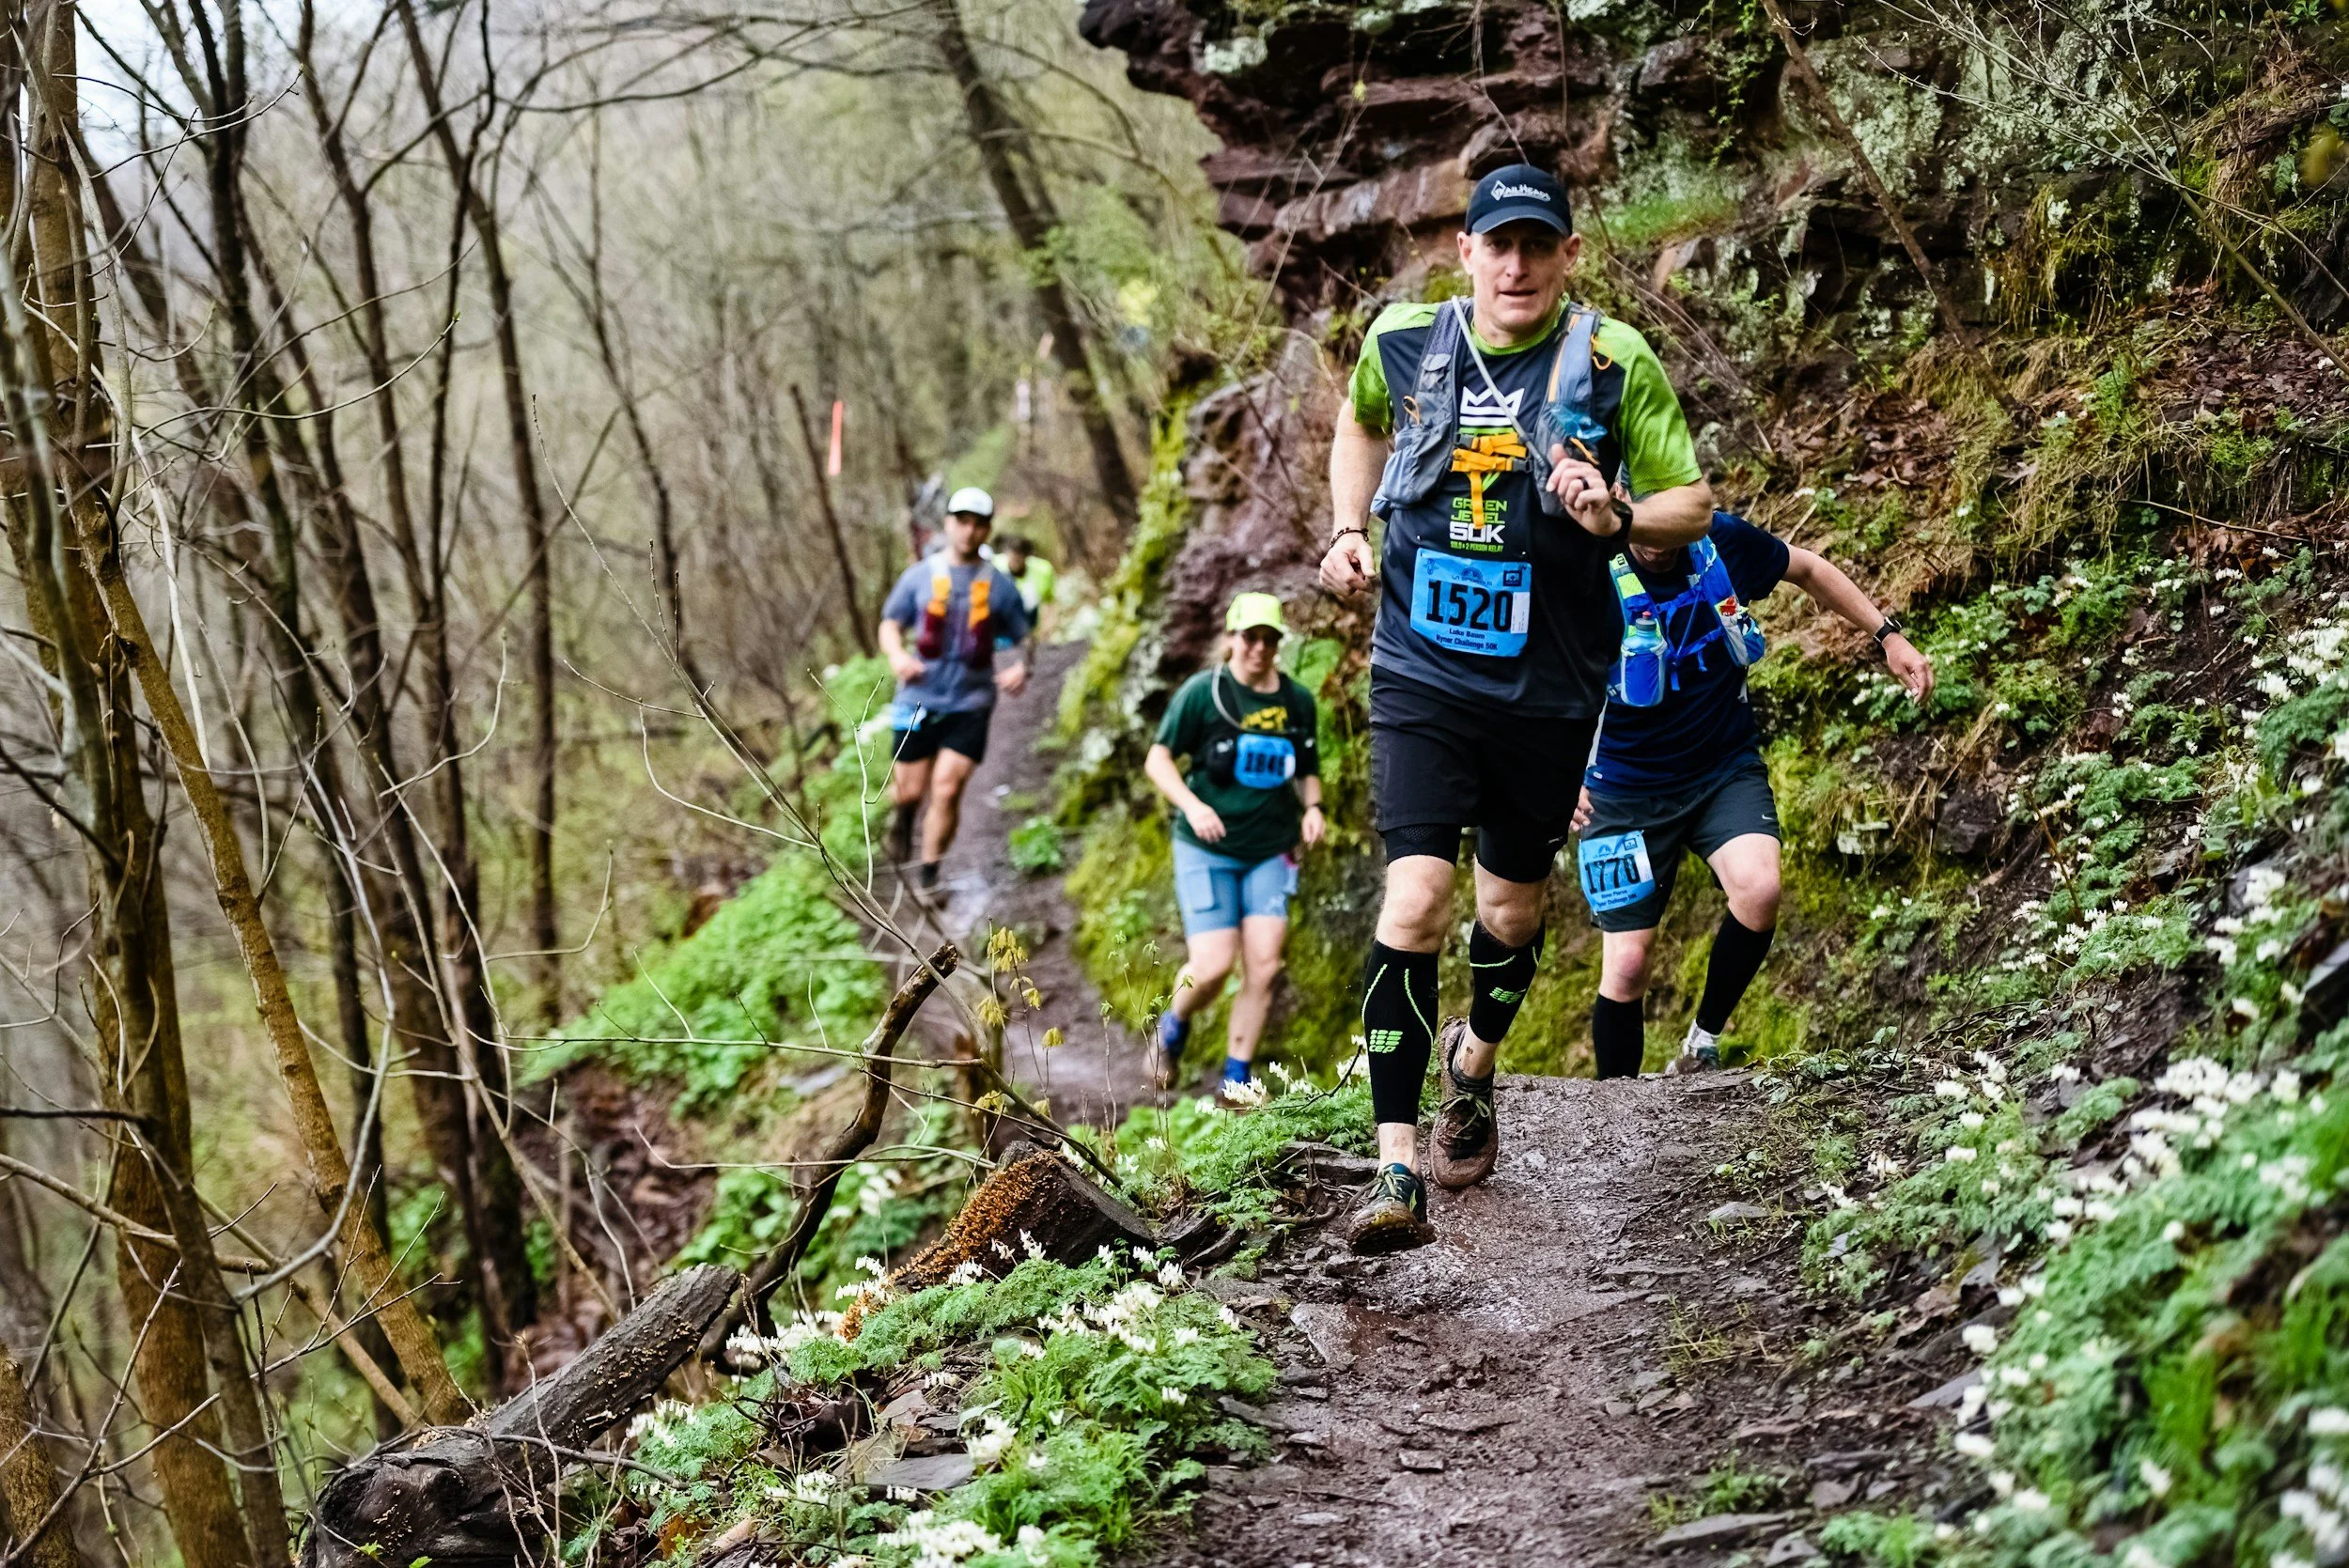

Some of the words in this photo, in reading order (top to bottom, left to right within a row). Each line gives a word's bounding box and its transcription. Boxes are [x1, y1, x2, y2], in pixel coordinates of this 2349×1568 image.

[1453, 497, 1508, 512] GREN
[1451, 510, 1506, 524] JEEL
[1450, 521, 1505, 544] 50K
[1426, 580, 1514, 632] 1520
[1450, 629, 1465, 637] Luke
[1437, 634, 1454, 644] Hyner
[1455, 637, 1485, 649] Challenge
[1486, 642, 1499, 651] 50K
[1585, 853, 1641, 895] 1770
[1369, 1045, 1396, 1053] cep
